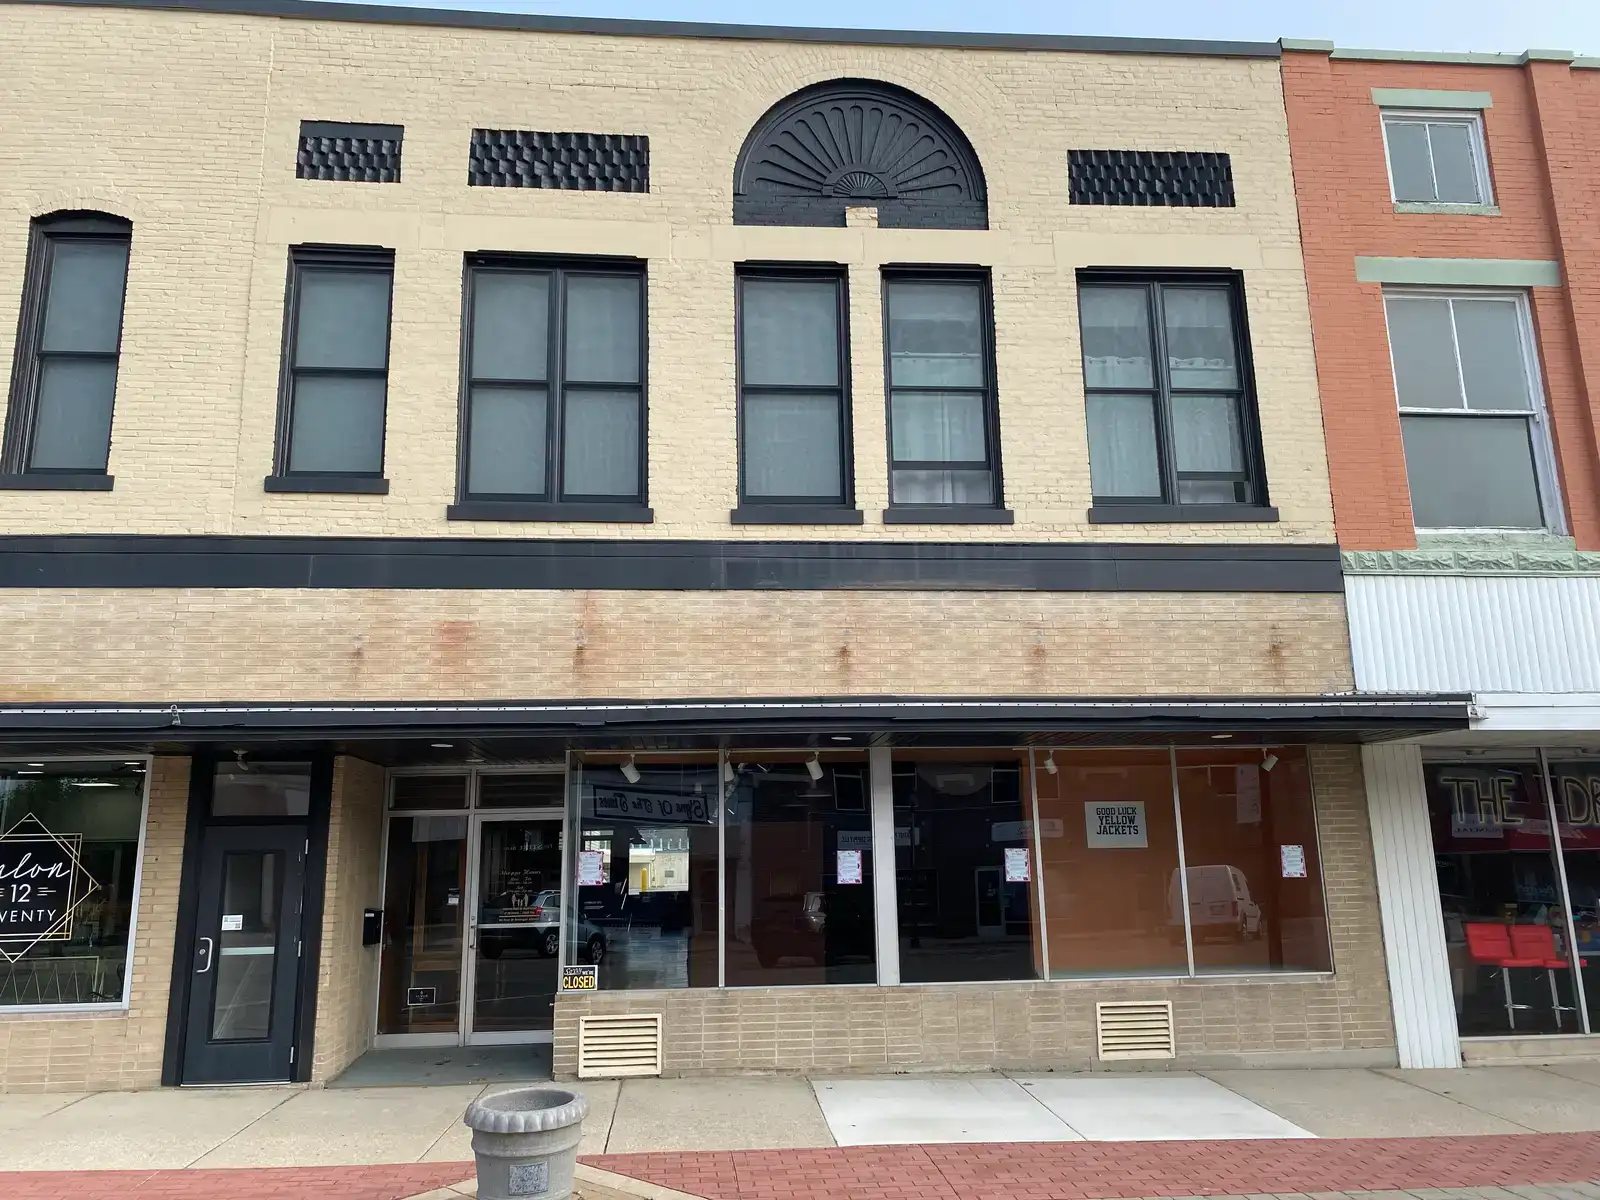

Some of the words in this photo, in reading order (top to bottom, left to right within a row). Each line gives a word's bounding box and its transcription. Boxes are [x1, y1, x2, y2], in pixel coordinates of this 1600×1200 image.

[1440, 775, 1525, 826] THE
[1096, 807, 1116, 815] GOOD
[1117, 806, 1137, 815] LUCK
[1098, 815, 1136, 825] YELLOW
[1096, 825, 1139, 835] JACKETS
[11, 884, 32, 903] 12
[563, 975, 595, 989] CLOSED
